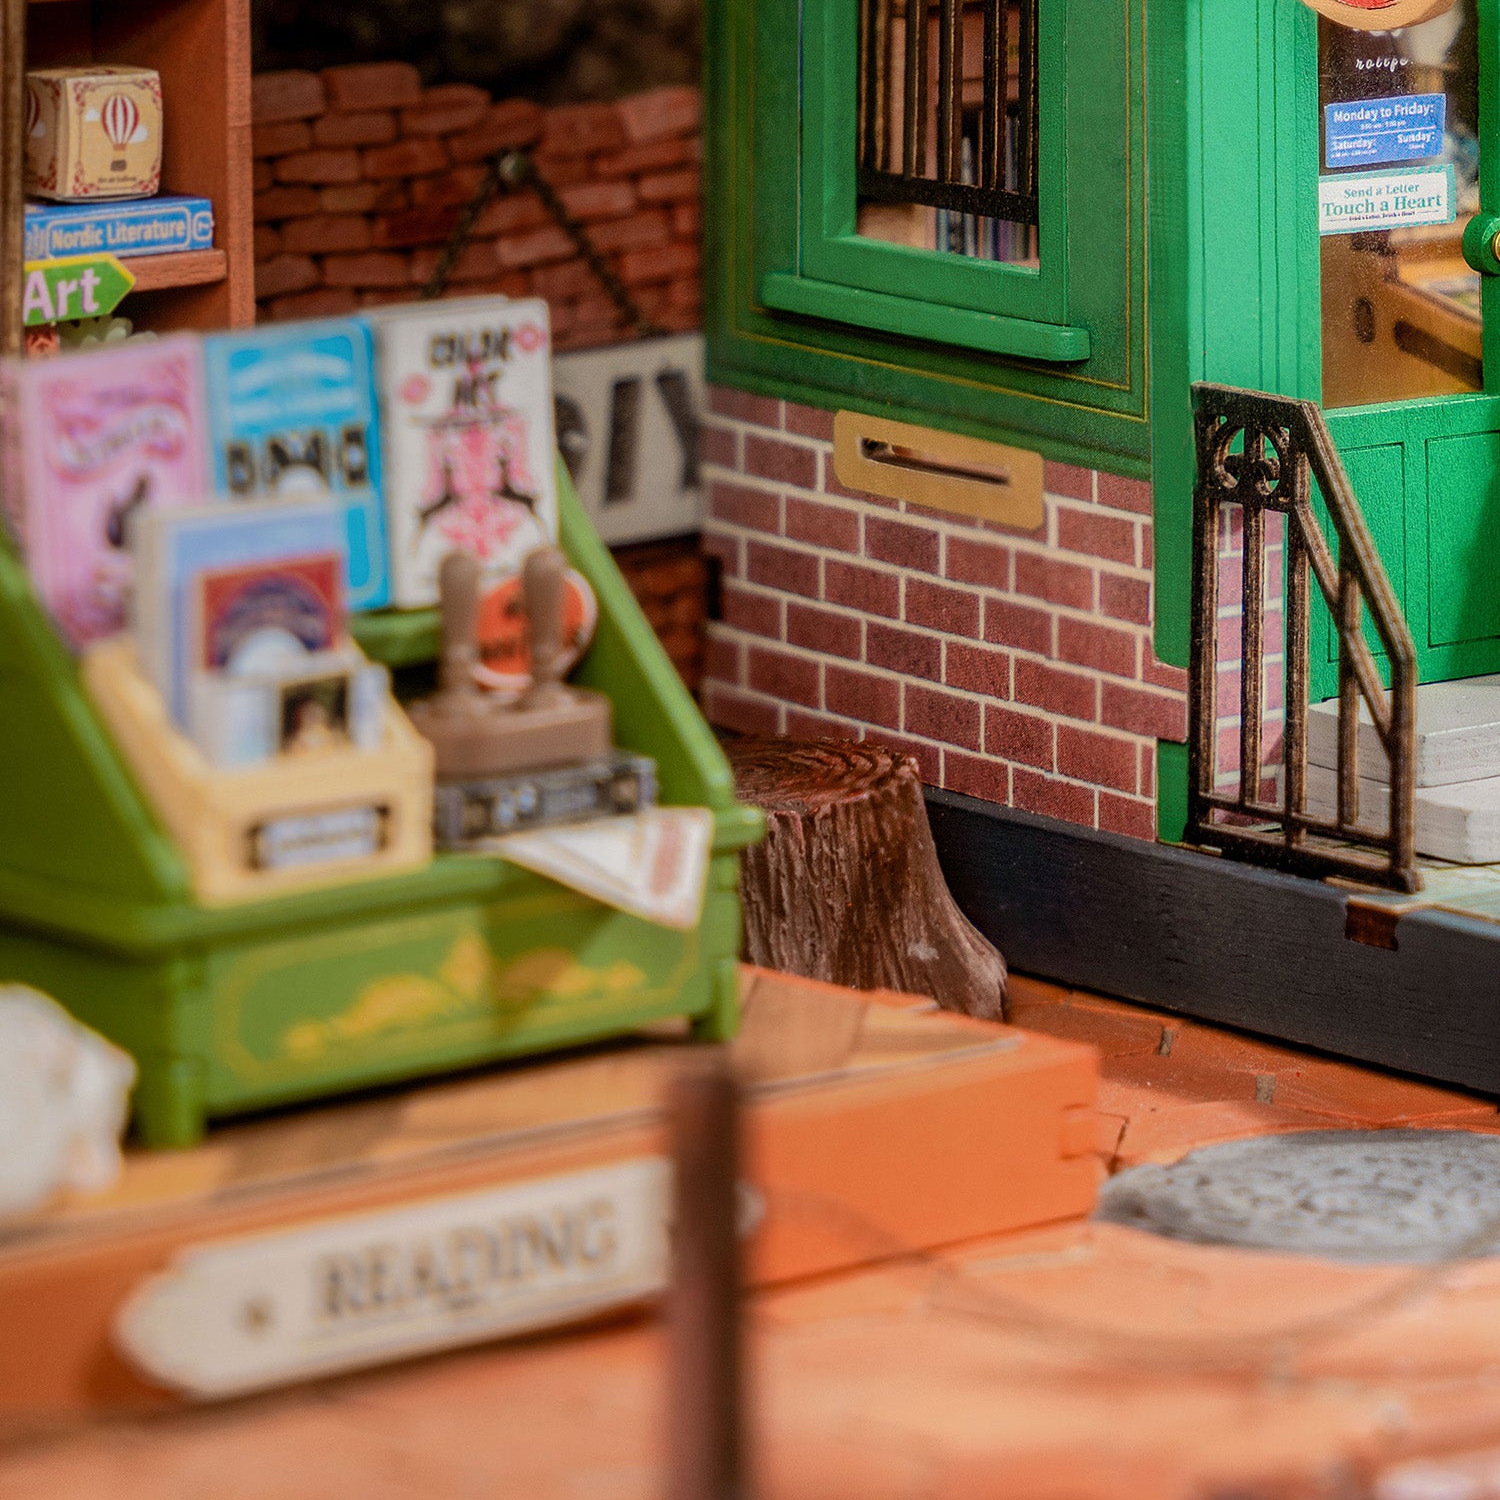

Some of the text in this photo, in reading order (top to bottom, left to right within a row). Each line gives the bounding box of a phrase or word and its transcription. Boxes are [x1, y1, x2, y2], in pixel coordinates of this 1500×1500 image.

[1334, 102, 1436, 124] Monday to Friday:
[1397, 131, 1435, 144] Sunday:
[1343, 183, 1420, 199] Send a Letter
[1322, 194, 1443, 217] Touch a Heart
[52, 222, 103, 249] Nordic
[106, 218, 185, 245] Literature
[22, 267, 102, 326] Art
[317, 1197, 618, 1322] READING
